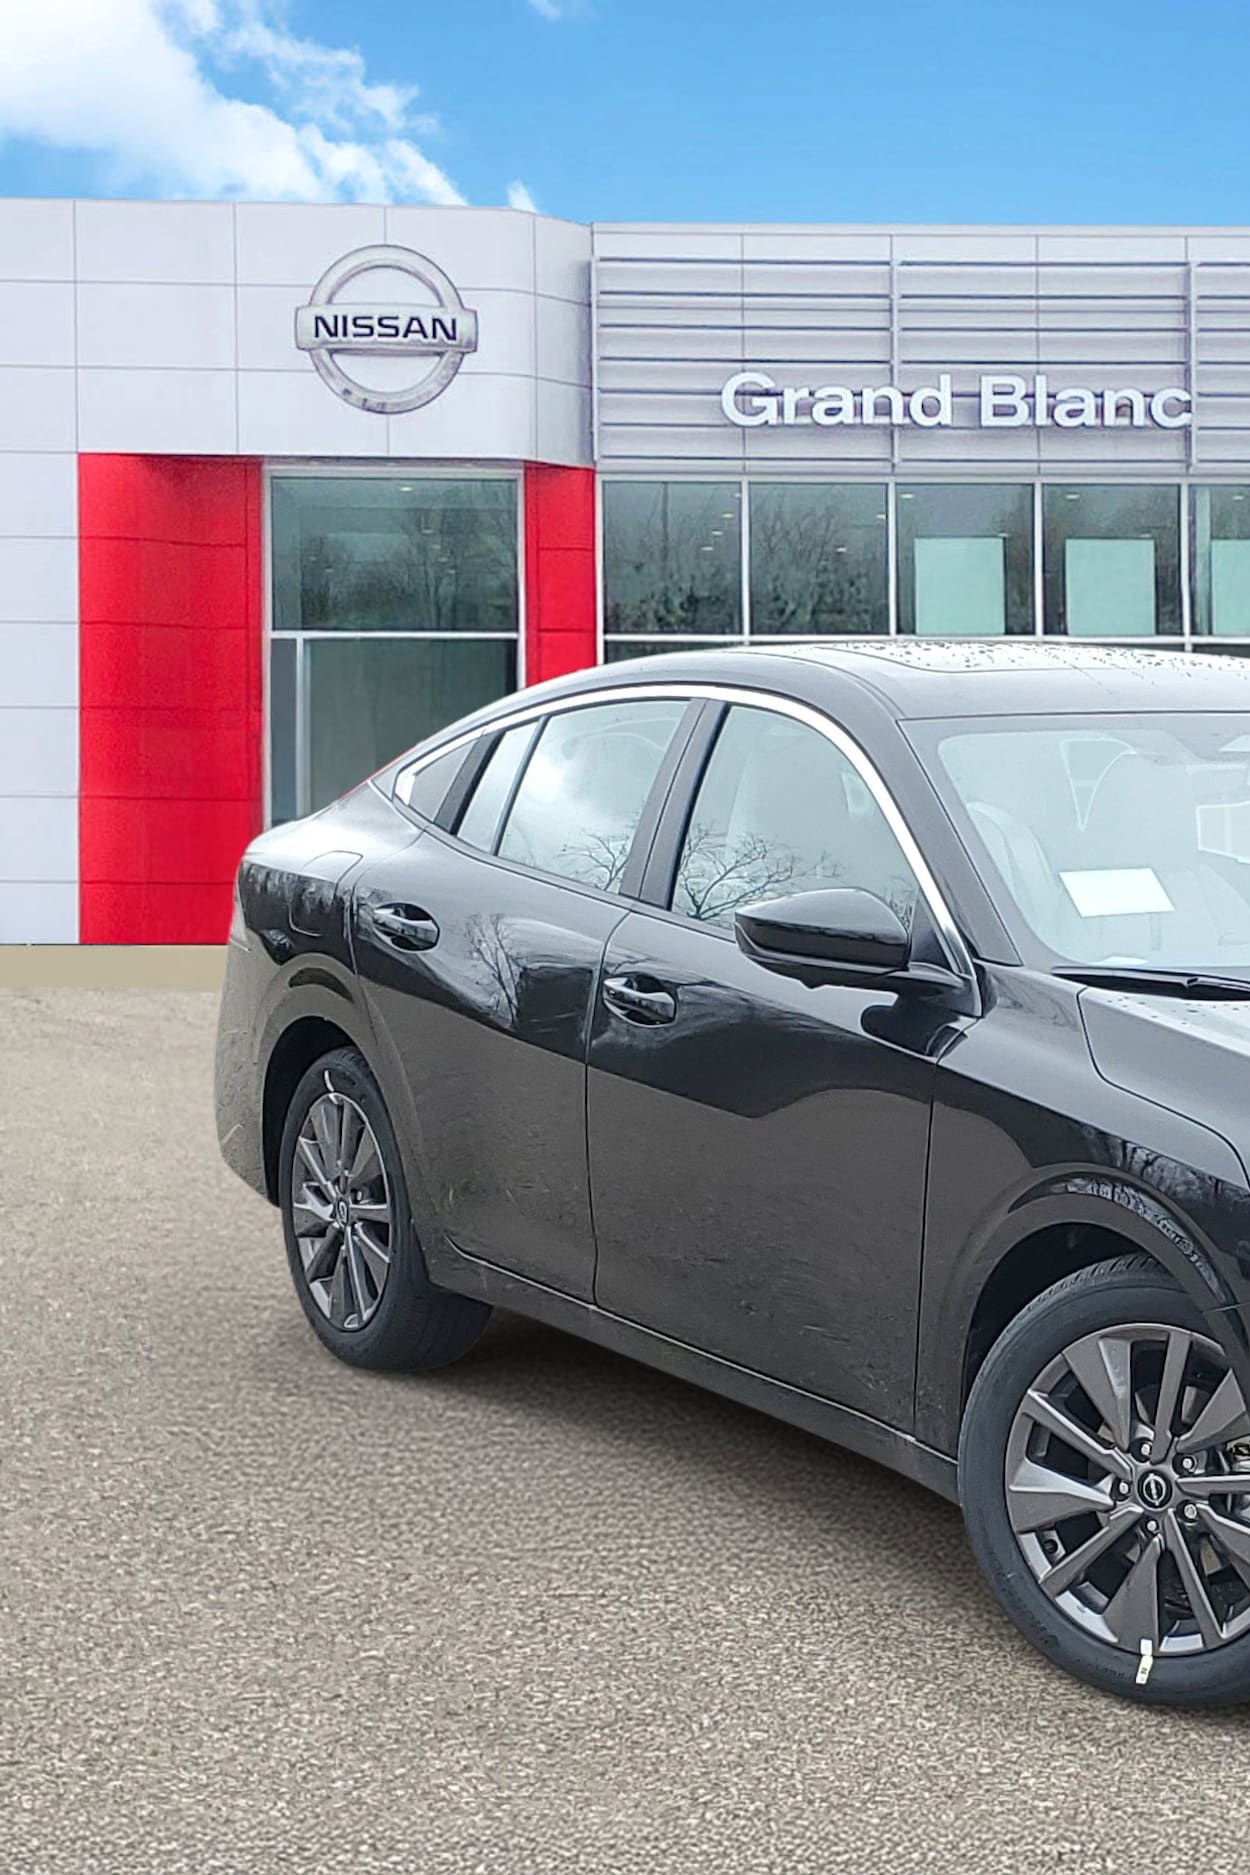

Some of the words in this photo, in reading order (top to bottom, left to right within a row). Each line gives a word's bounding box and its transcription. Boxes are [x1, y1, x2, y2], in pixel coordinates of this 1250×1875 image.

[314, 315, 457, 341] NISSAN
[720, 371, 952, 428] Grand
[978, 373, 1193, 429] Blanc
